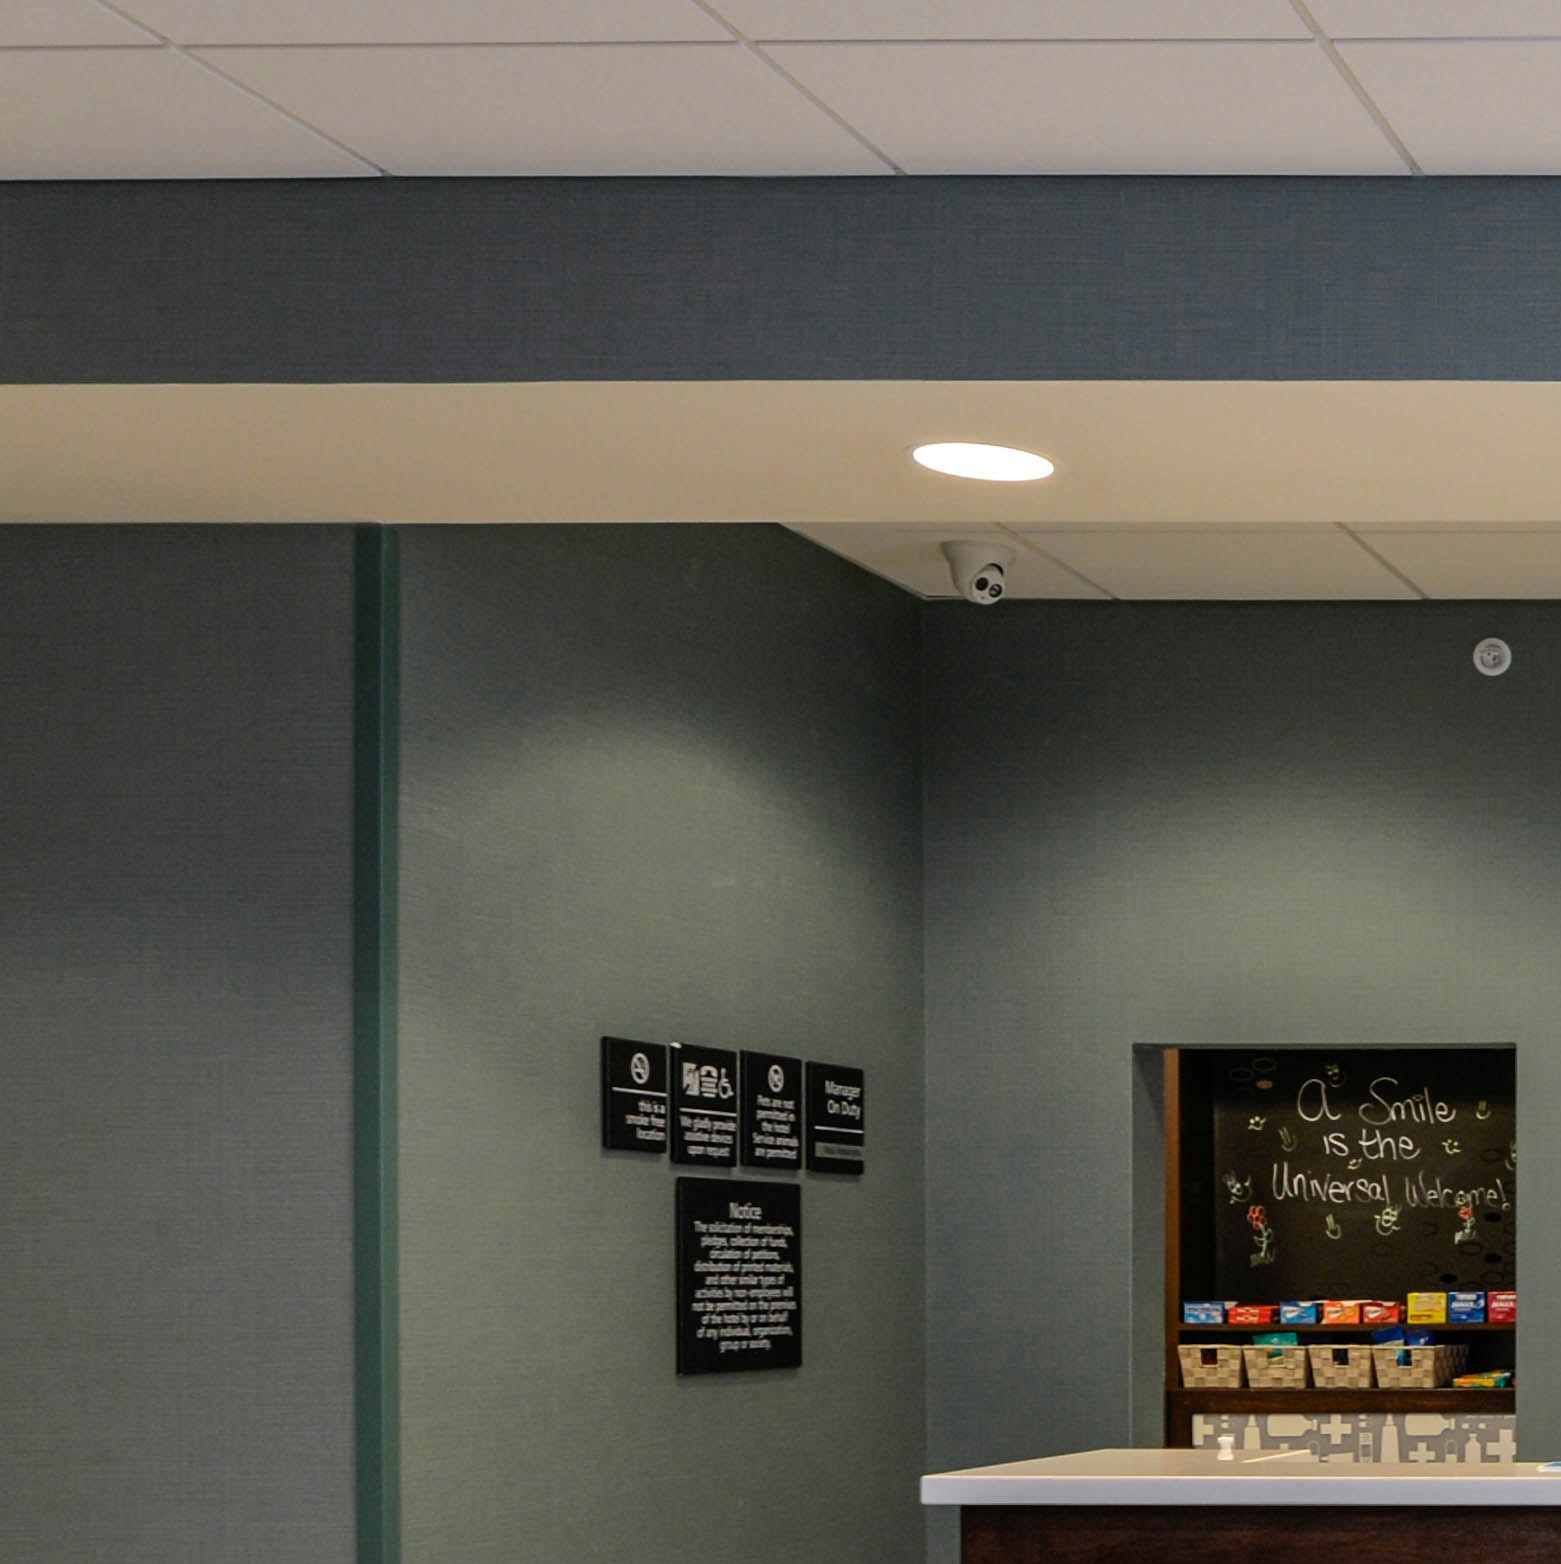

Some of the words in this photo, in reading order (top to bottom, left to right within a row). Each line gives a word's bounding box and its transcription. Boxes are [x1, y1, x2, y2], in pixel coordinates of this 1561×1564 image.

[824, 1080, 861, 1101] Manager
[1358, 1077, 1456, 1126] Smile
[826, 1099, 840, 1114] On
[841, 1101, 861, 1120] Duty
[1323, 1132, 1349, 1156] is
[1358, 1129, 1421, 1160] the
[1272, 1161, 1391, 1204] Universal
[1405, 1169, 1511, 1211] Welcome!
[729, 1202, 762, 1220] Notice
